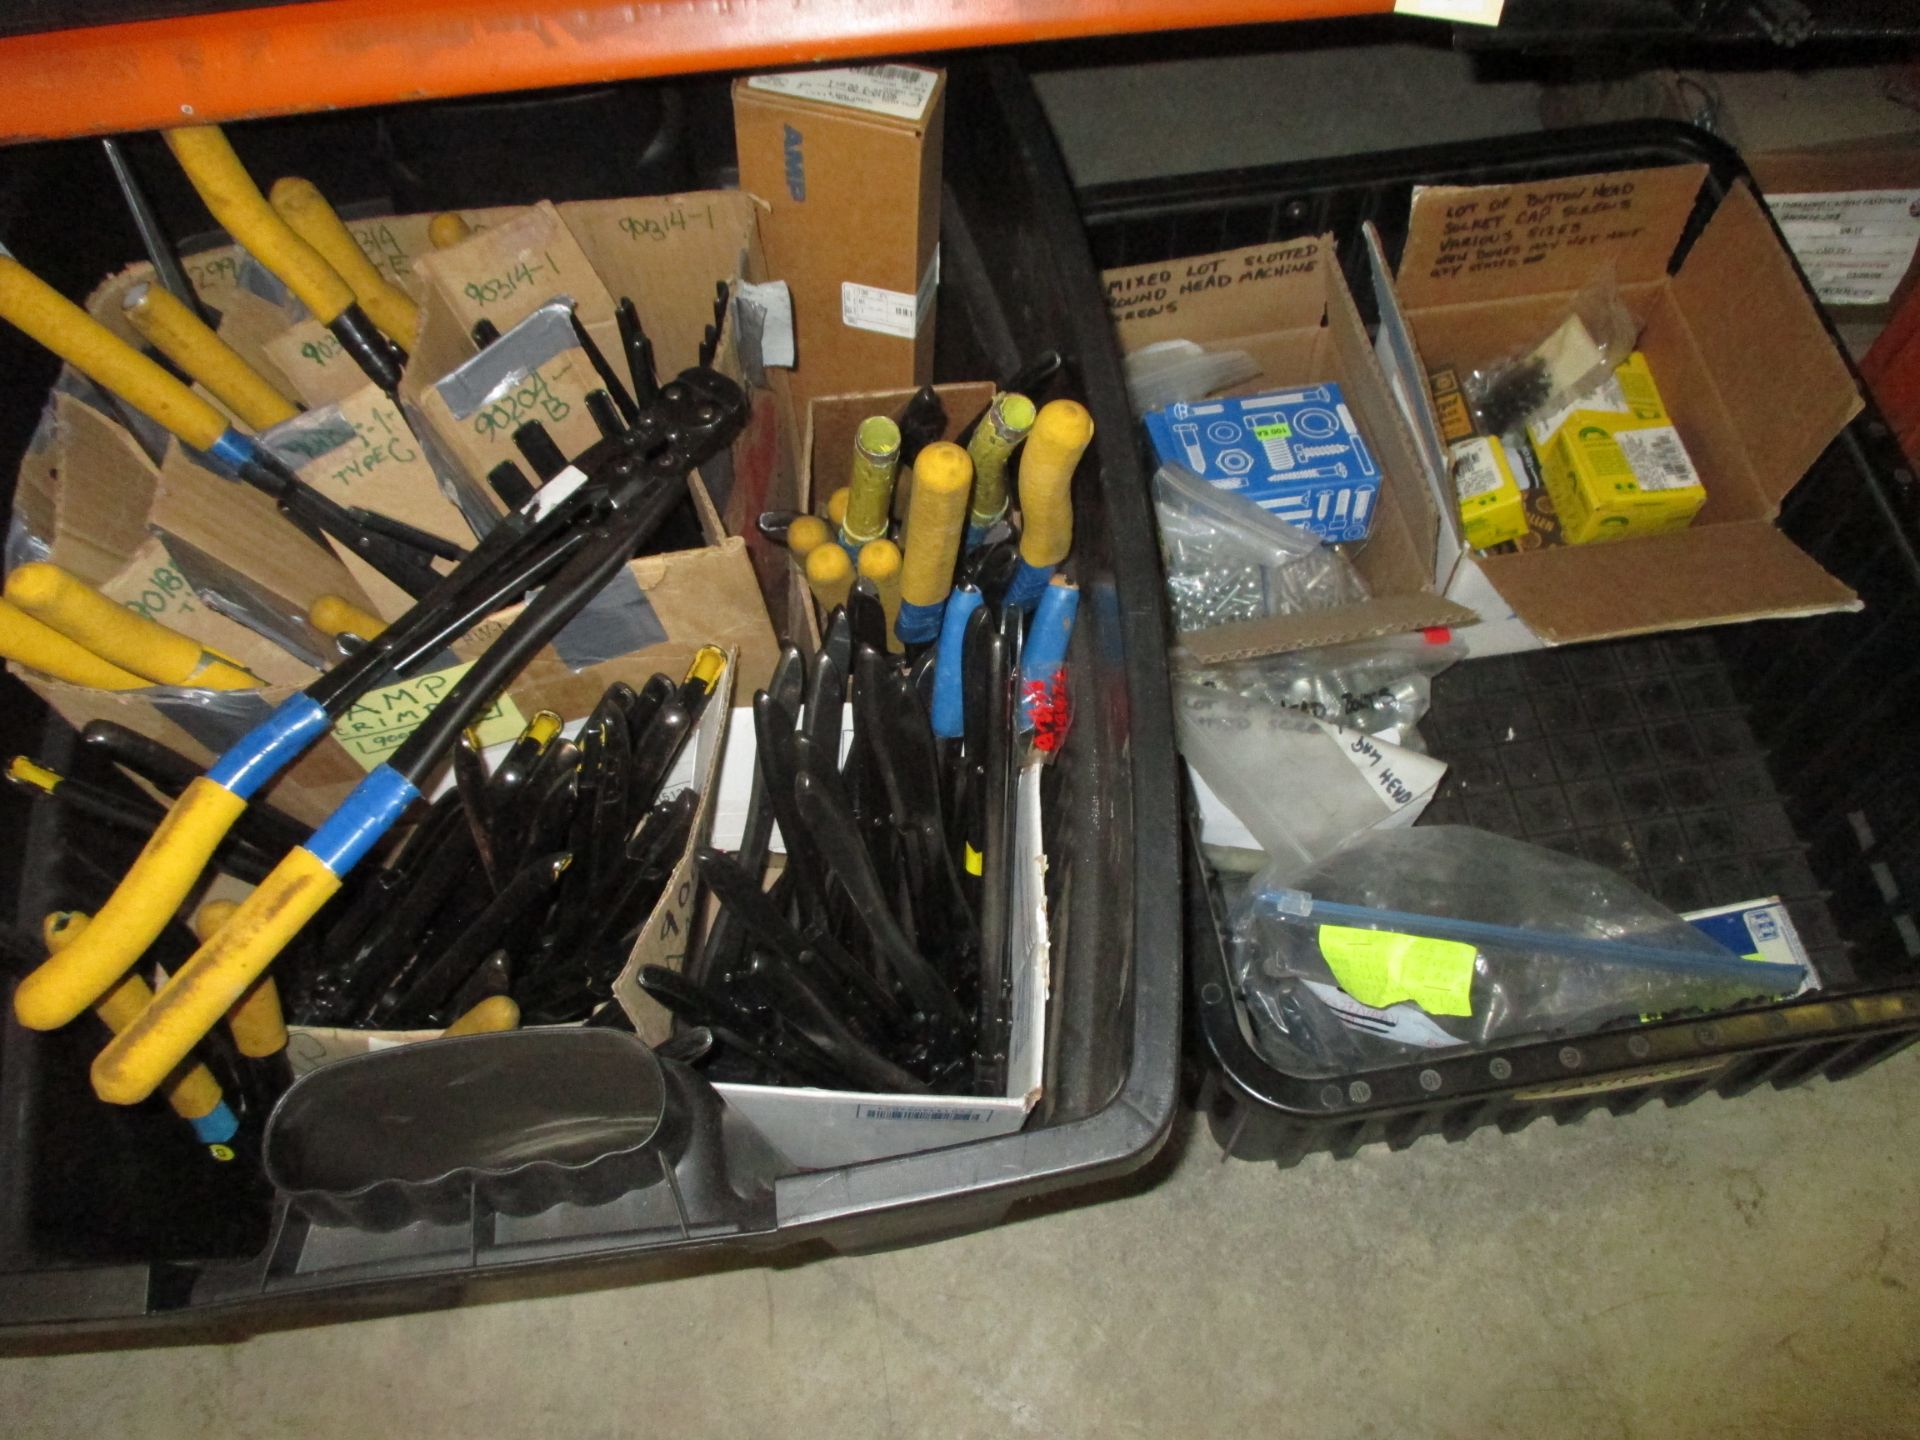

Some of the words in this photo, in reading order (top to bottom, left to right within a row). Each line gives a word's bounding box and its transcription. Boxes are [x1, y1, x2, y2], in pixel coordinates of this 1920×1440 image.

[783, 122, 807, 203] AMP
[618, 205, 715, 241] 90314-1
[1514, 206, 1552, 226] CAP
[463, 251, 561, 307] 90314-1
[1107, 269, 1172, 296] MIXED
[1186, 258, 1226, 278] LOT
[1243, 243, 1319, 267] SLOTTED
[1179, 274, 1232, 295] HEAD
[1238, 259, 1318, 284] MACHINE
[331, 444, 388, 486] TYPE
[388, 436, 417, 463] C
[346, 674, 447, 722] AMP
